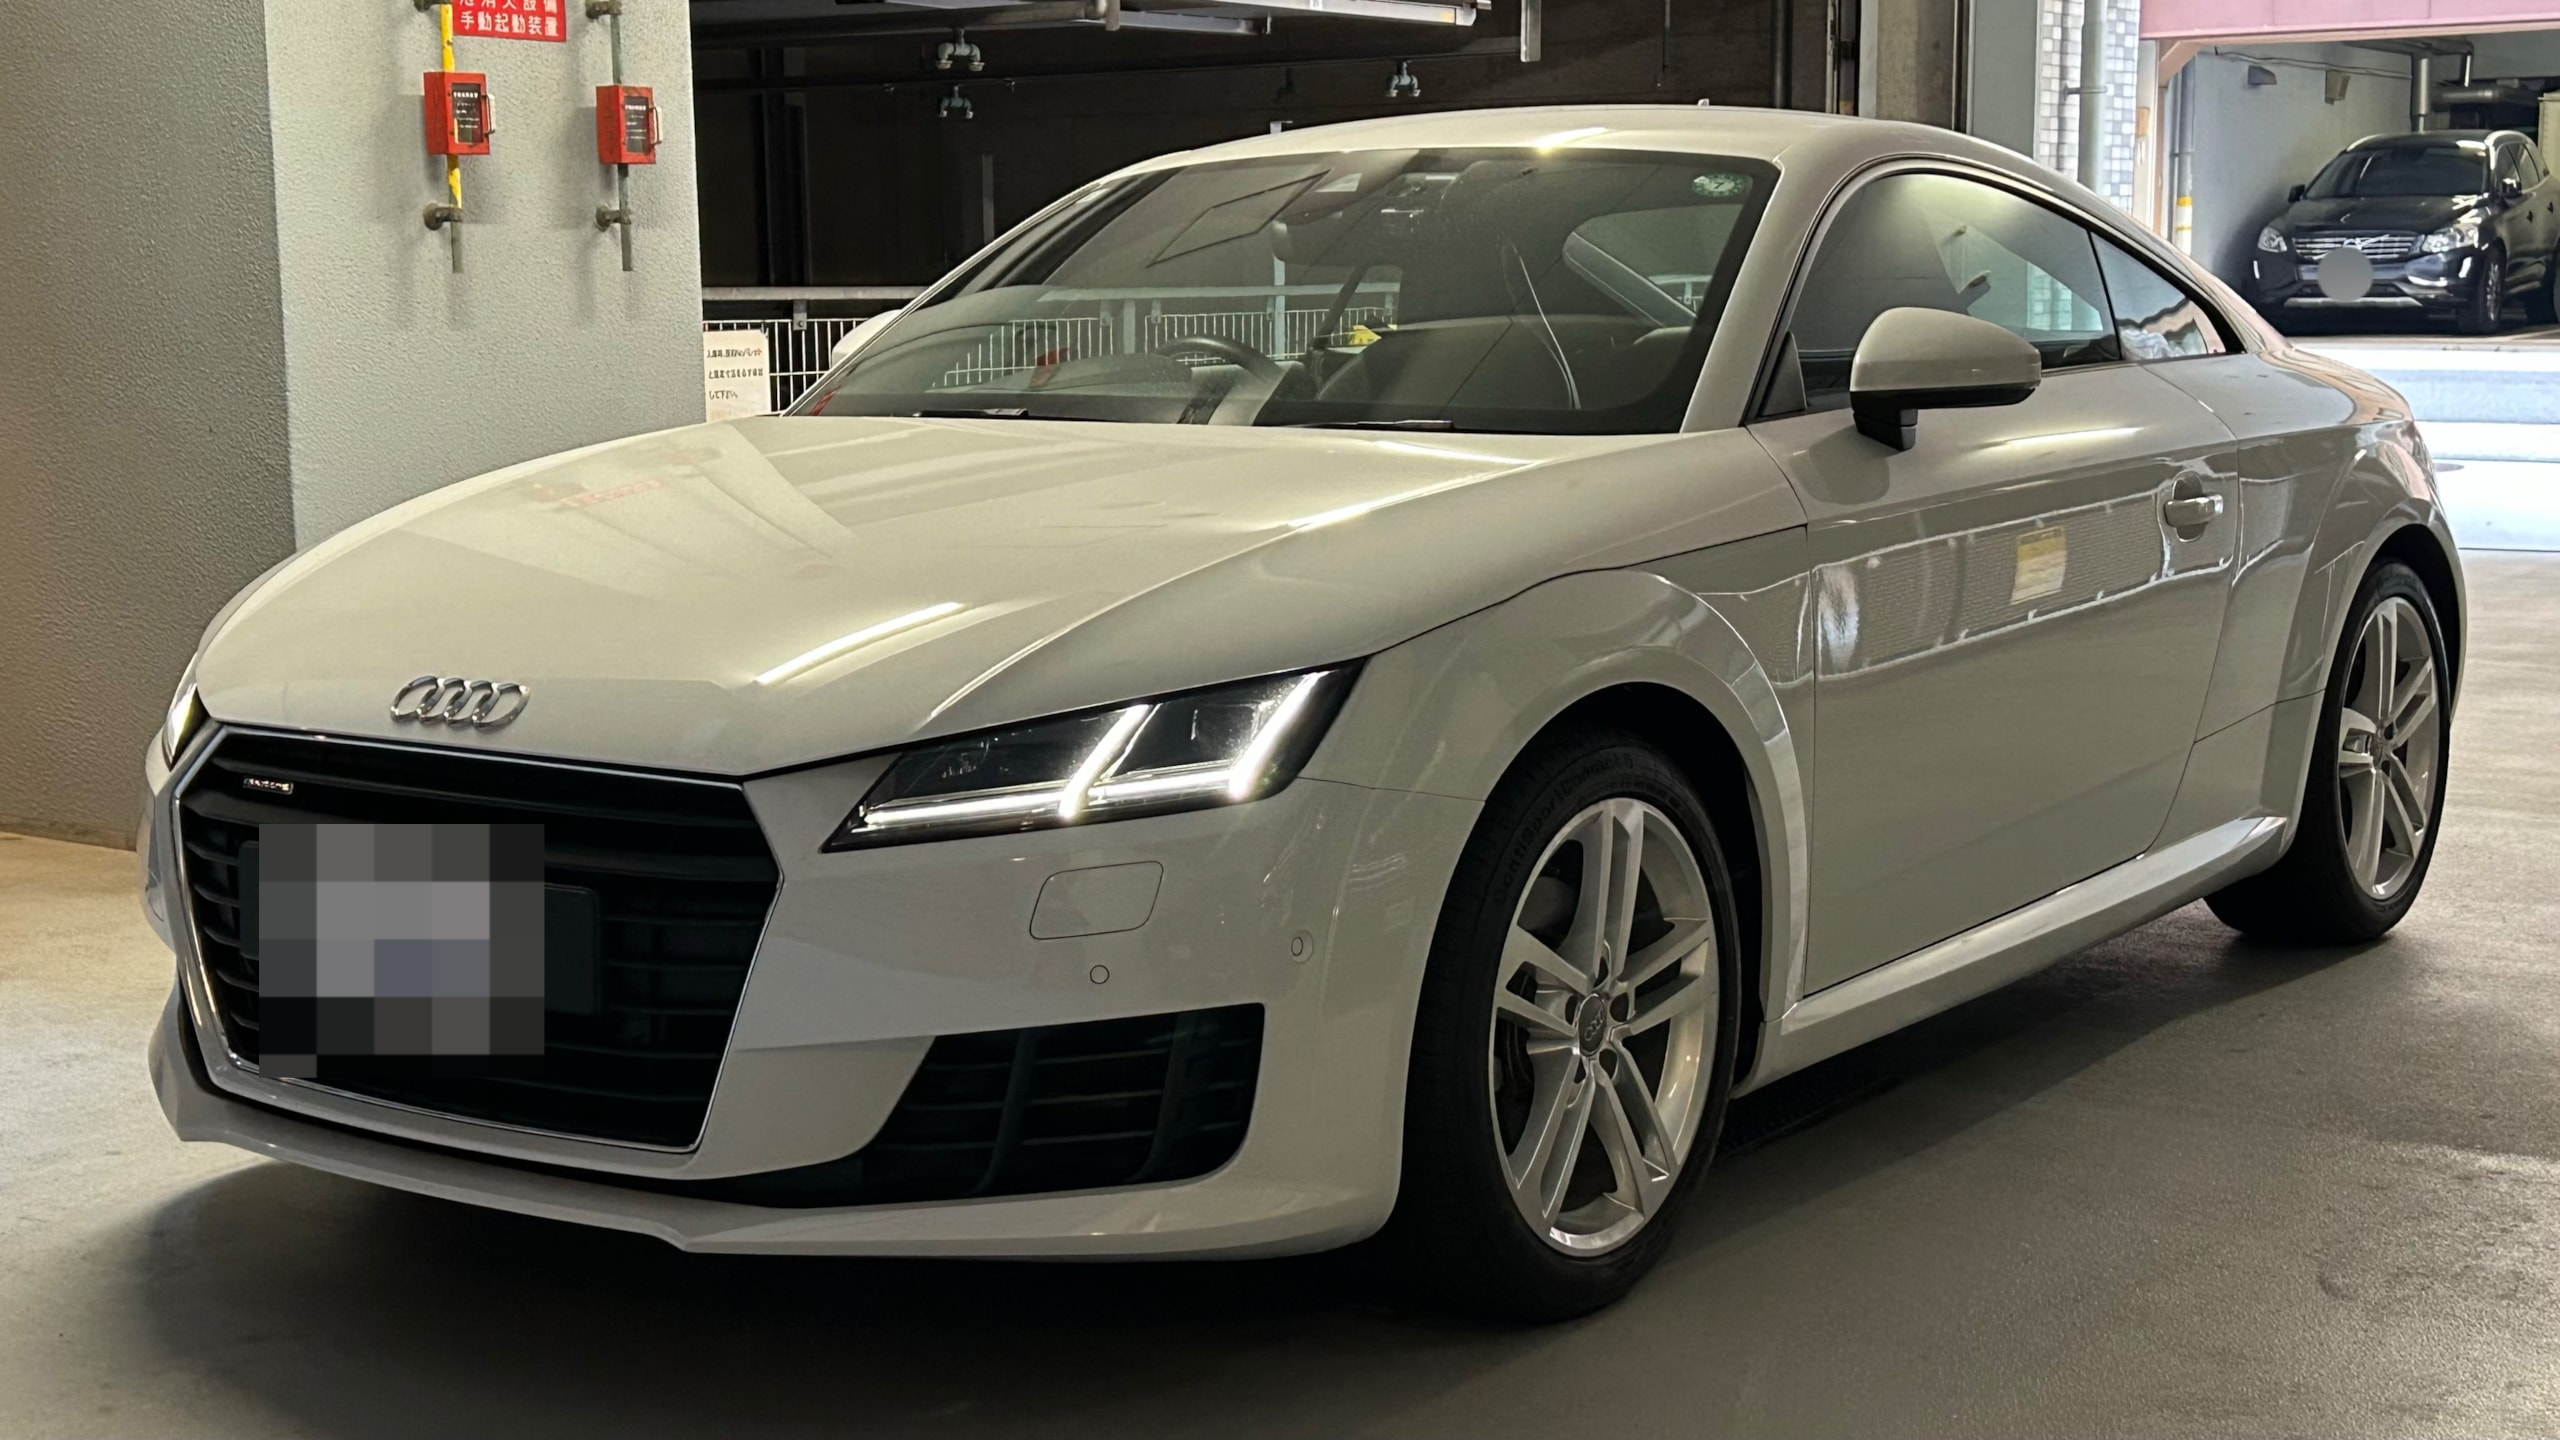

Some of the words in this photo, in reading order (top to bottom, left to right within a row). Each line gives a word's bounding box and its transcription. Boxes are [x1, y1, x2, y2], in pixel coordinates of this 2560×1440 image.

[460, 10, 559, 37] 手動起動装置
